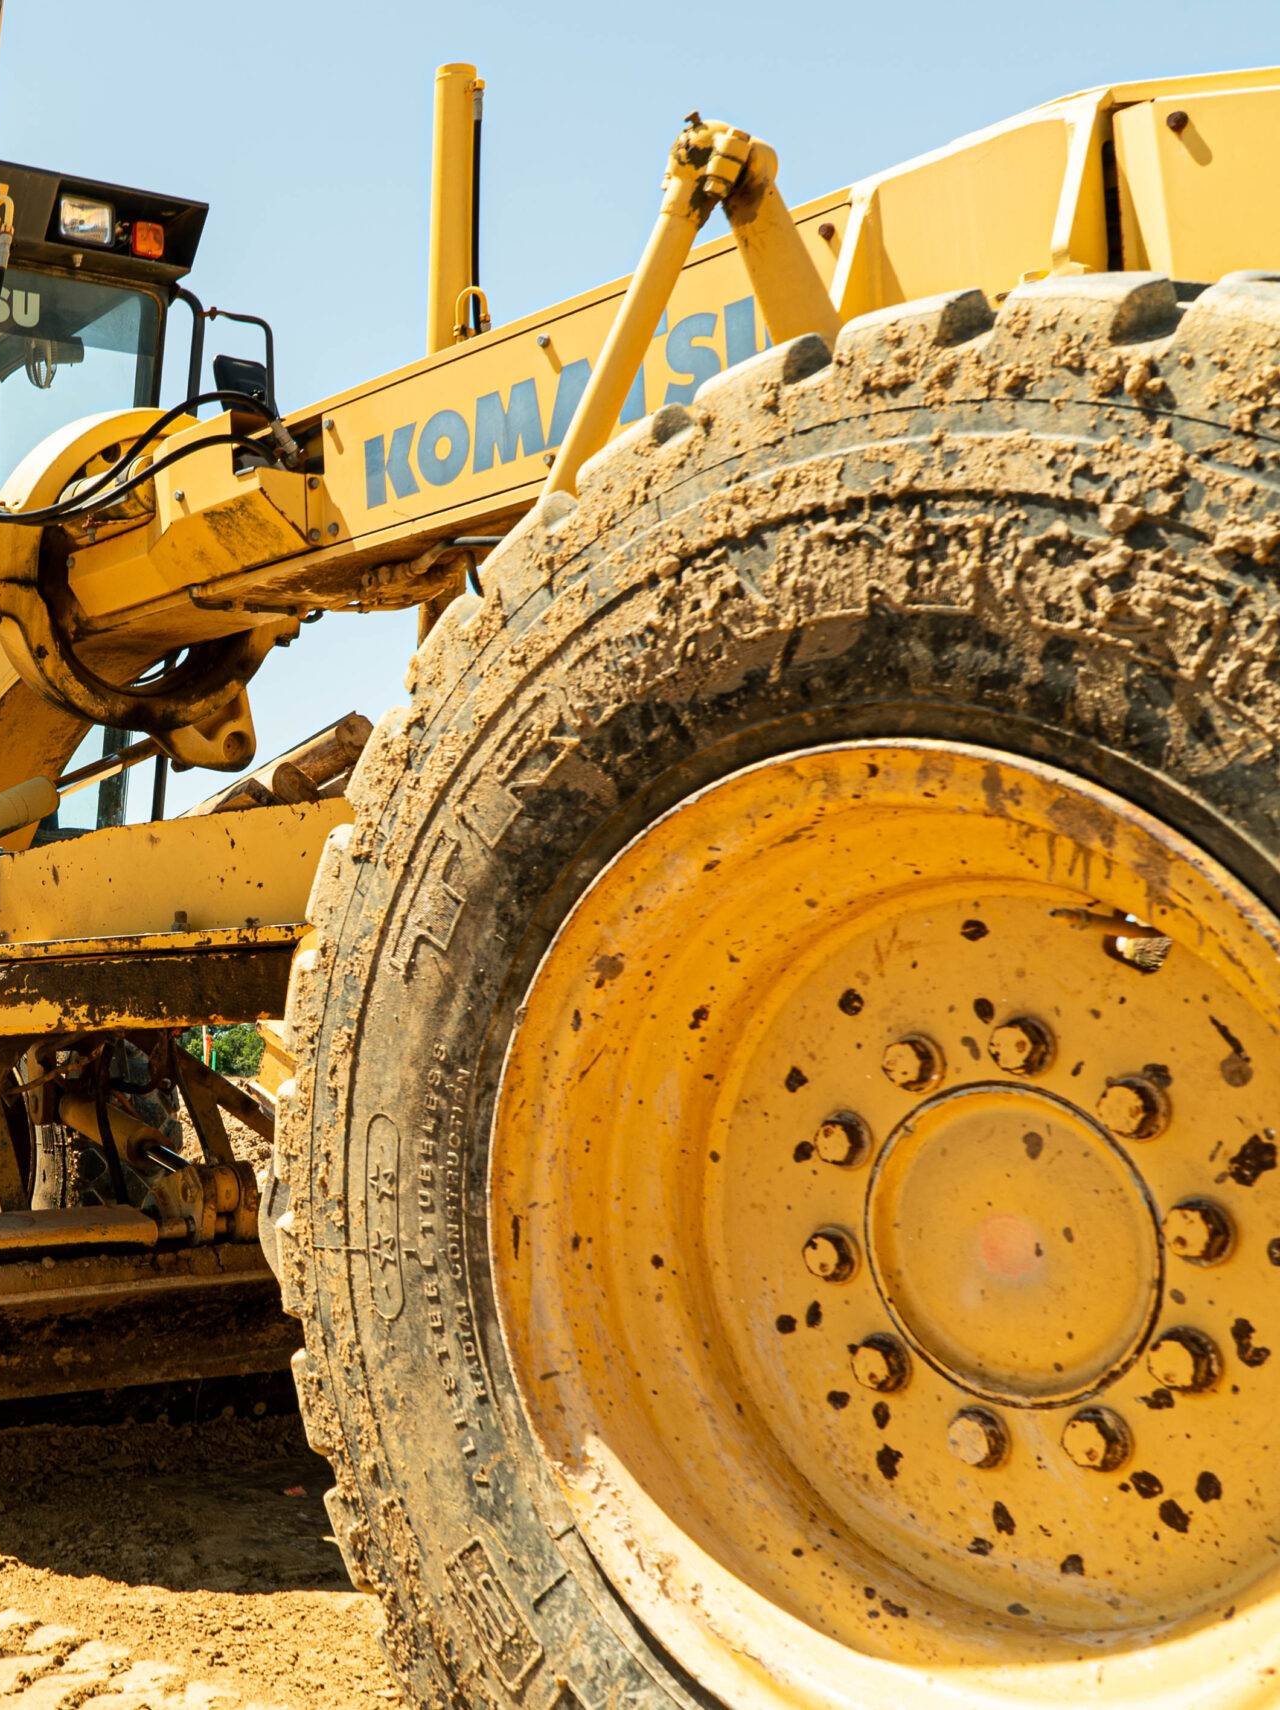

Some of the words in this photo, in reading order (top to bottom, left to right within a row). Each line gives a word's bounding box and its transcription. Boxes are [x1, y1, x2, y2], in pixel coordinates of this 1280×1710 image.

[418, 1043, 448, 1239] TUBELESS
[447, 1067, 471, 1281] CONSTRUCTION
[420, 1250, 458, 1396] STEEL
[455, 1301, 487, 1398] RADIAL
